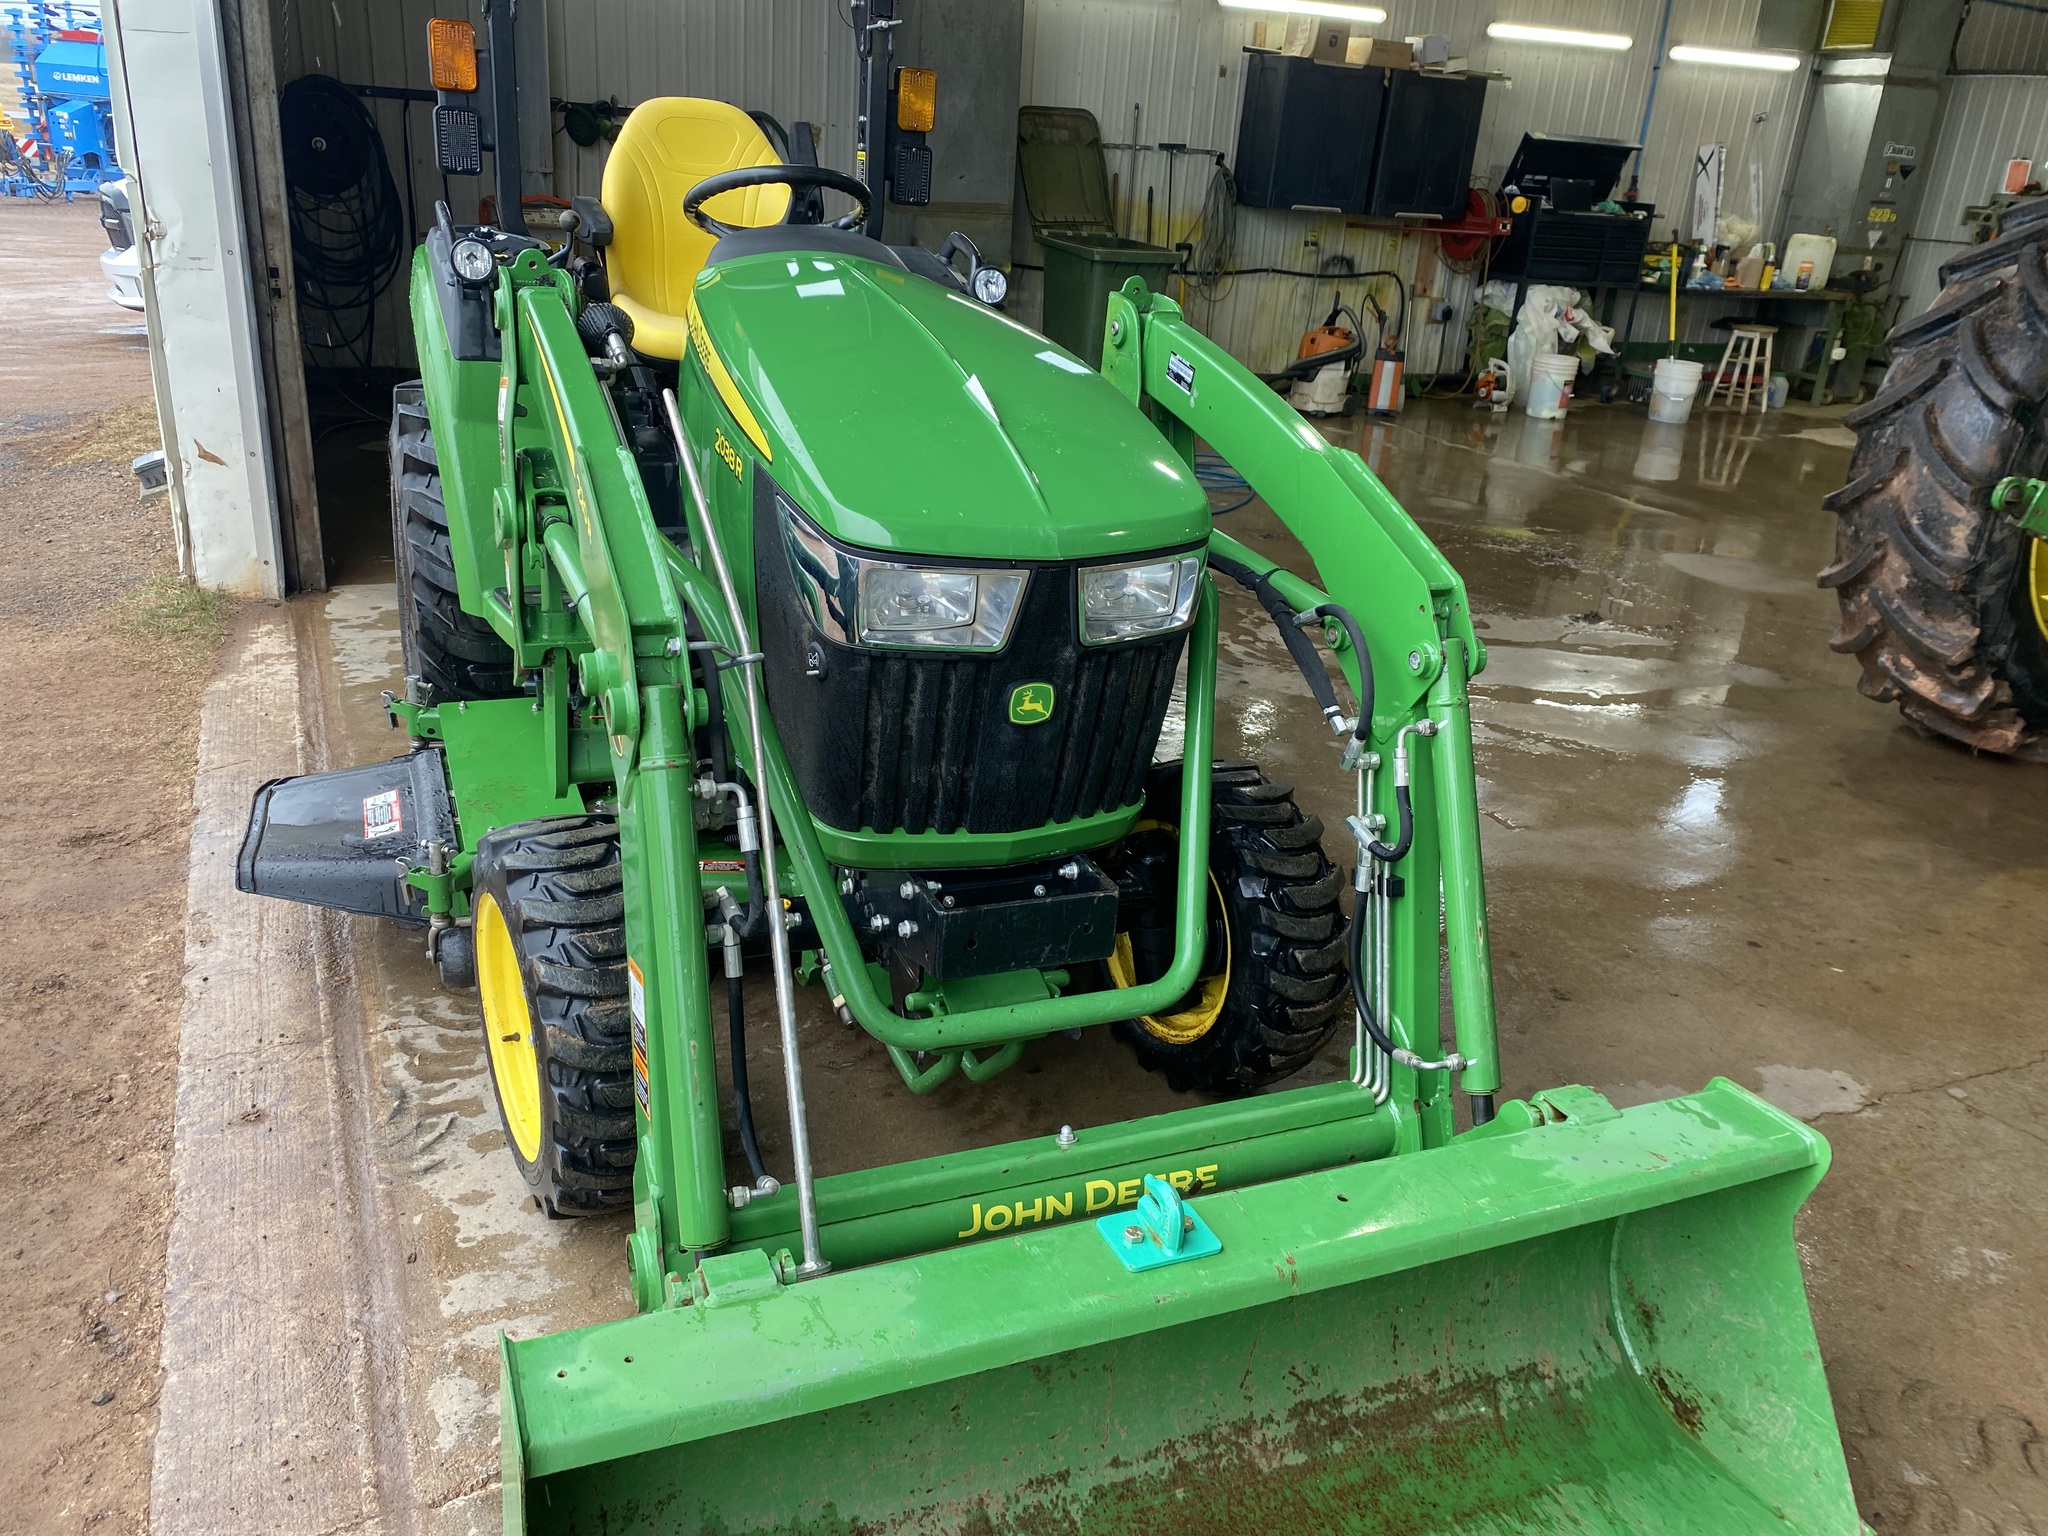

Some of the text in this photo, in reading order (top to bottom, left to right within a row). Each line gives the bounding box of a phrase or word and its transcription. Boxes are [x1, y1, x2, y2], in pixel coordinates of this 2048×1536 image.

[62, 72, 100, 84] LEMKEN
[715, 426, 742, 484] 2038R
[958, 1191, 1073, 1238] JOHN
